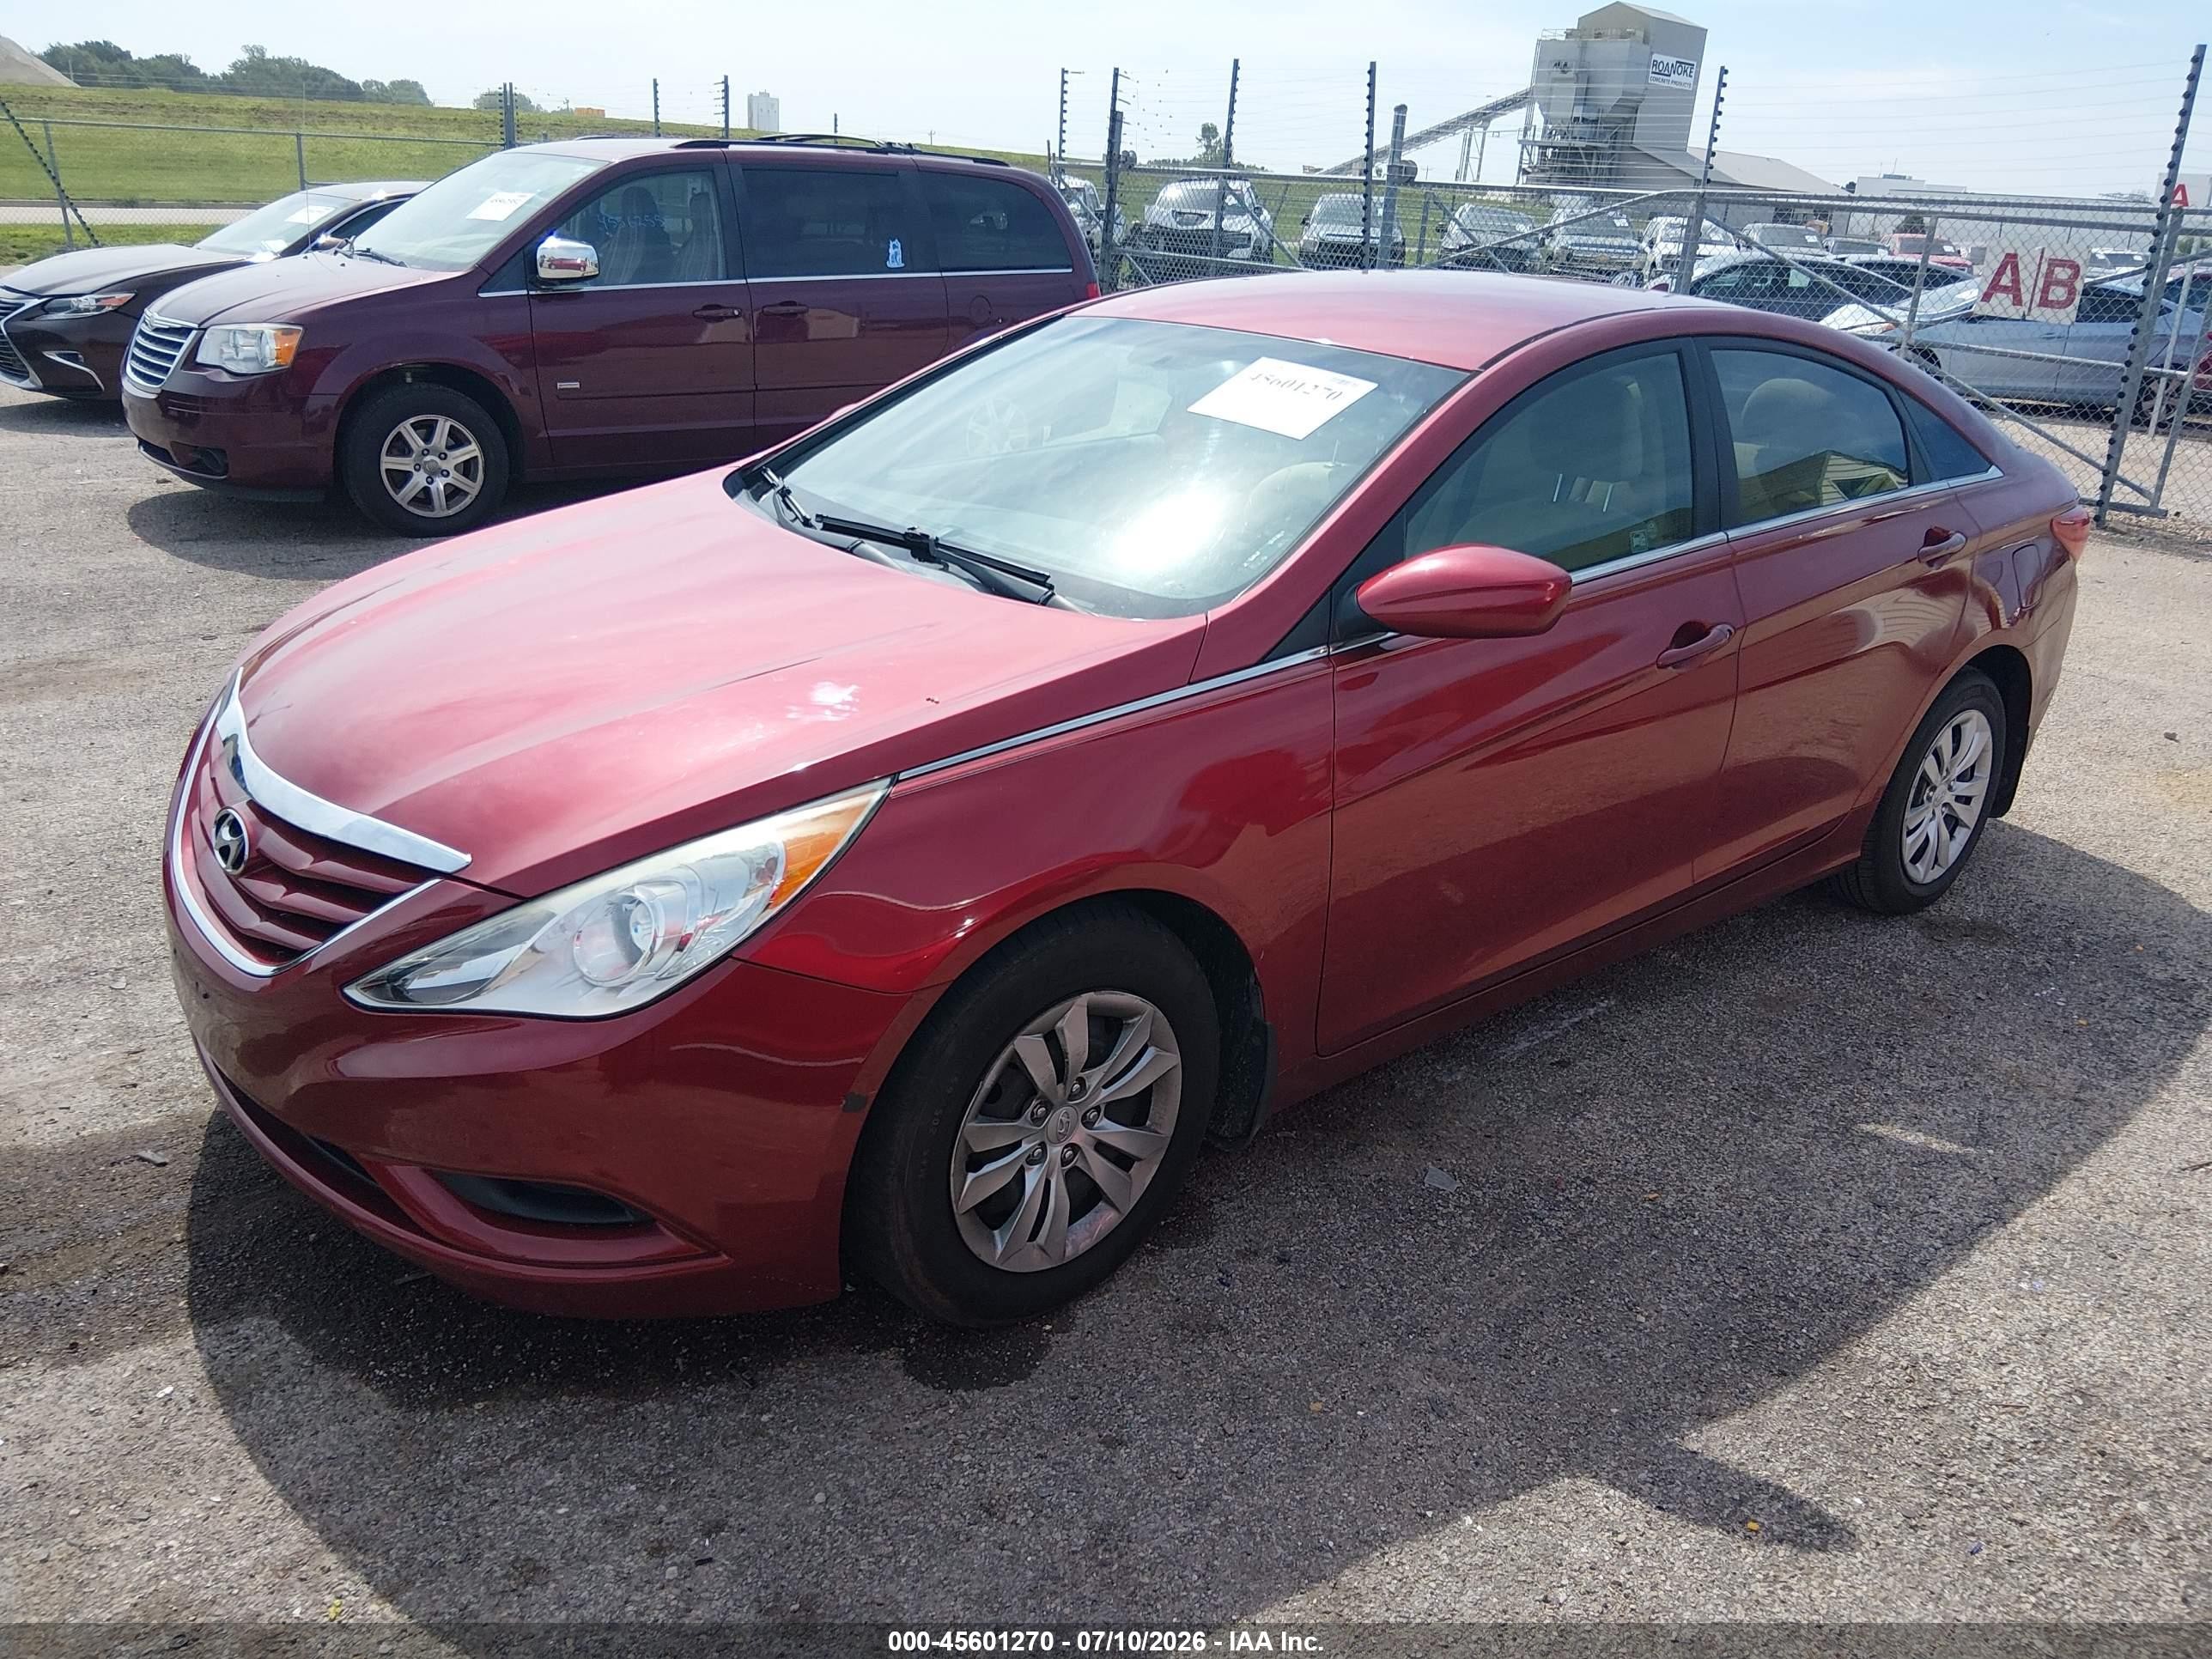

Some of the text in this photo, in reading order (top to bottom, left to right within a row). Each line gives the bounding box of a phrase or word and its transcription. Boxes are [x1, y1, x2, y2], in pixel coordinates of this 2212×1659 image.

[1651, 59, 1695, 78] ROANOKE
[1650, 76, 1670, 84] CONCRETE
[2171, 184, 2189, 206] A
